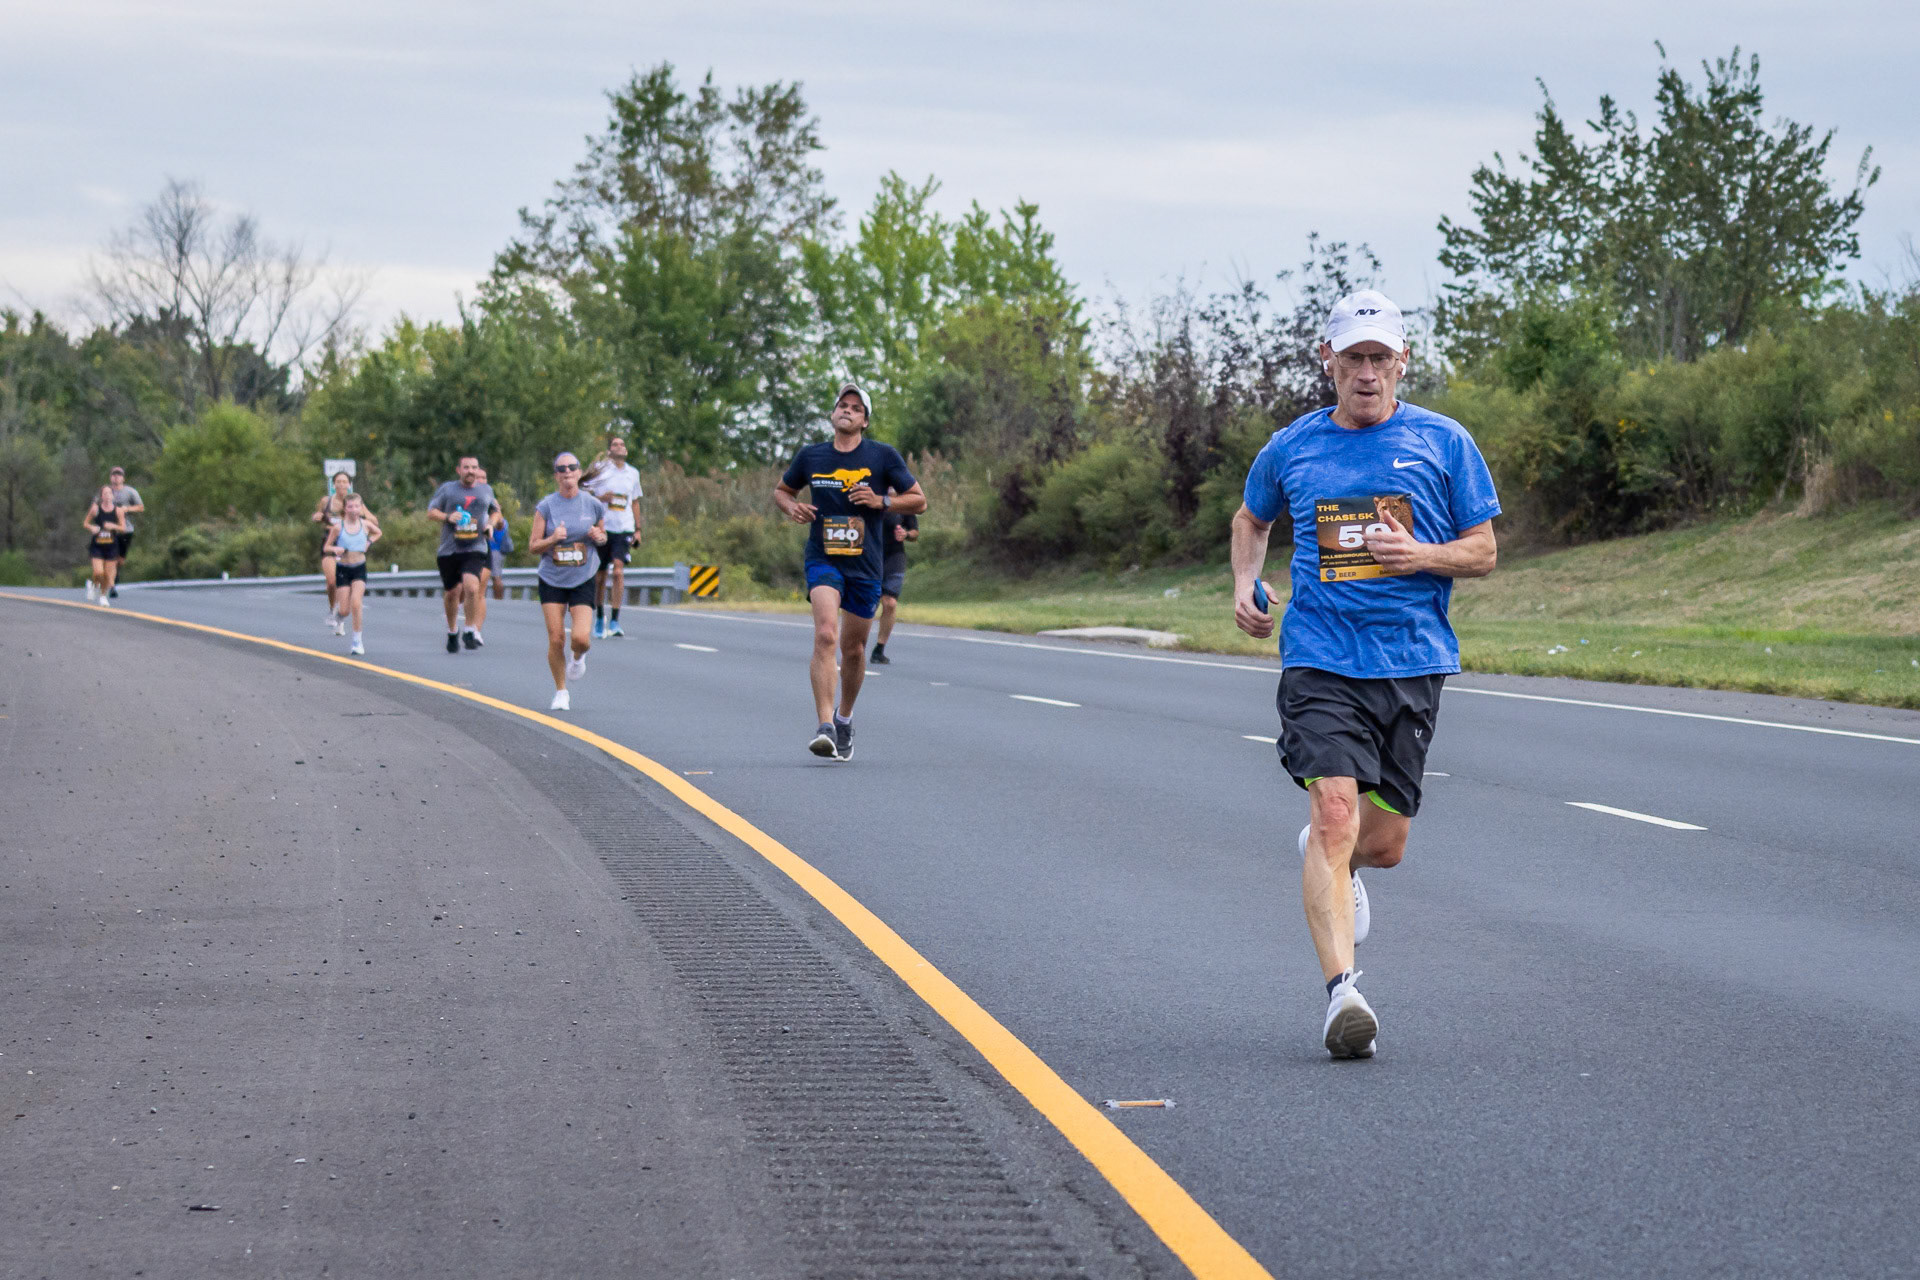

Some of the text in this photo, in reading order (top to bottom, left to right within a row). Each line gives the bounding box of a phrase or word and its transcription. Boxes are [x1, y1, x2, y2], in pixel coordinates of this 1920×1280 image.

[1316, 504, 1339, 512] THE
[1317, 512, 1374, 522] CHASE 5K
[826, 528, 859, 541] 140
